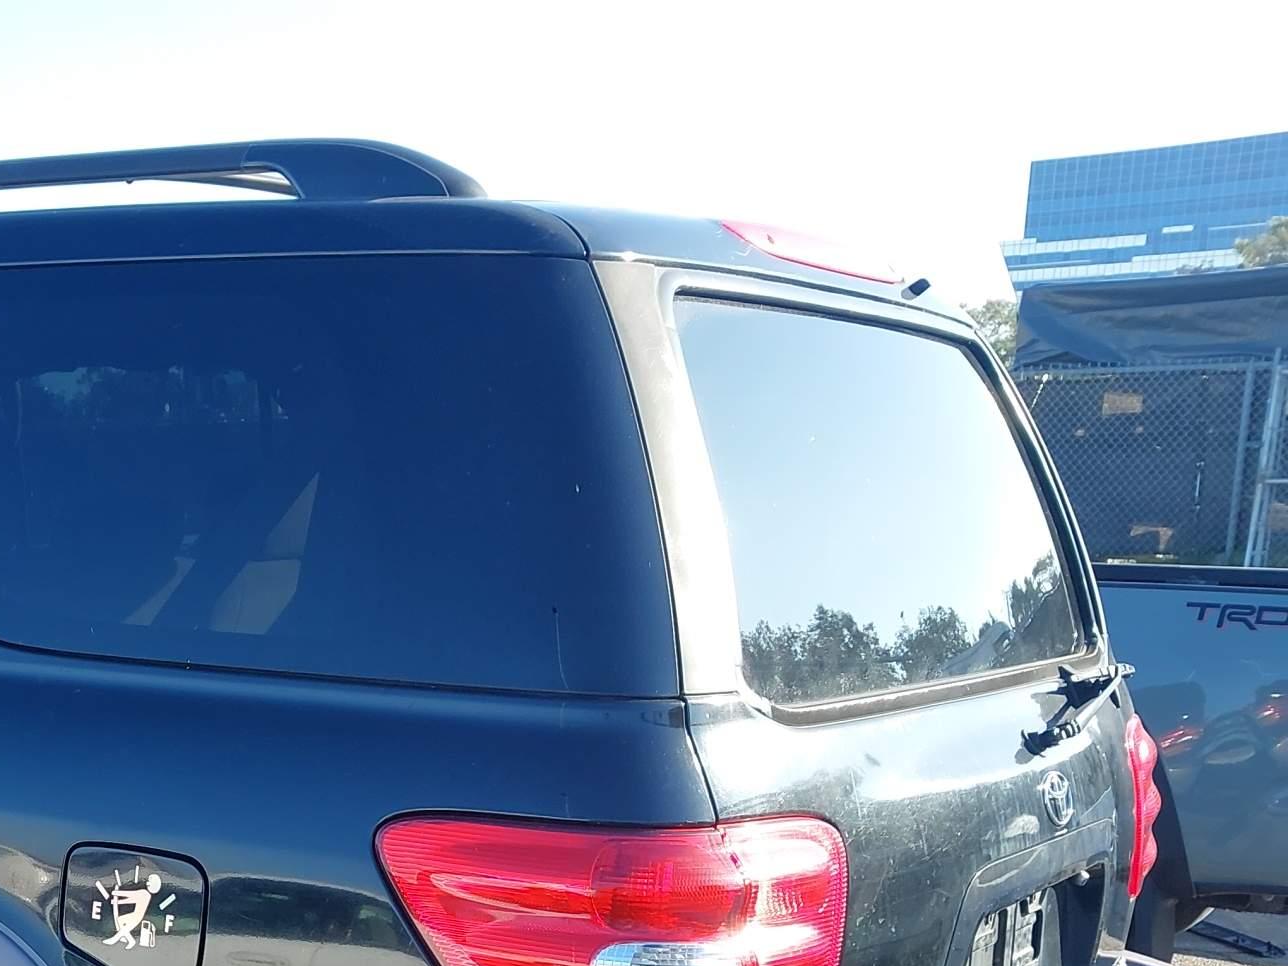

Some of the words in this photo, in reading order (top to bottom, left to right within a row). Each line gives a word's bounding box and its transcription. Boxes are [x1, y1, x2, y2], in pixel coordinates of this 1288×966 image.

[1186, 601, 1288, 631] TRD
[91, 900, 103, 920] E
[164, 914, 175, 933] F
